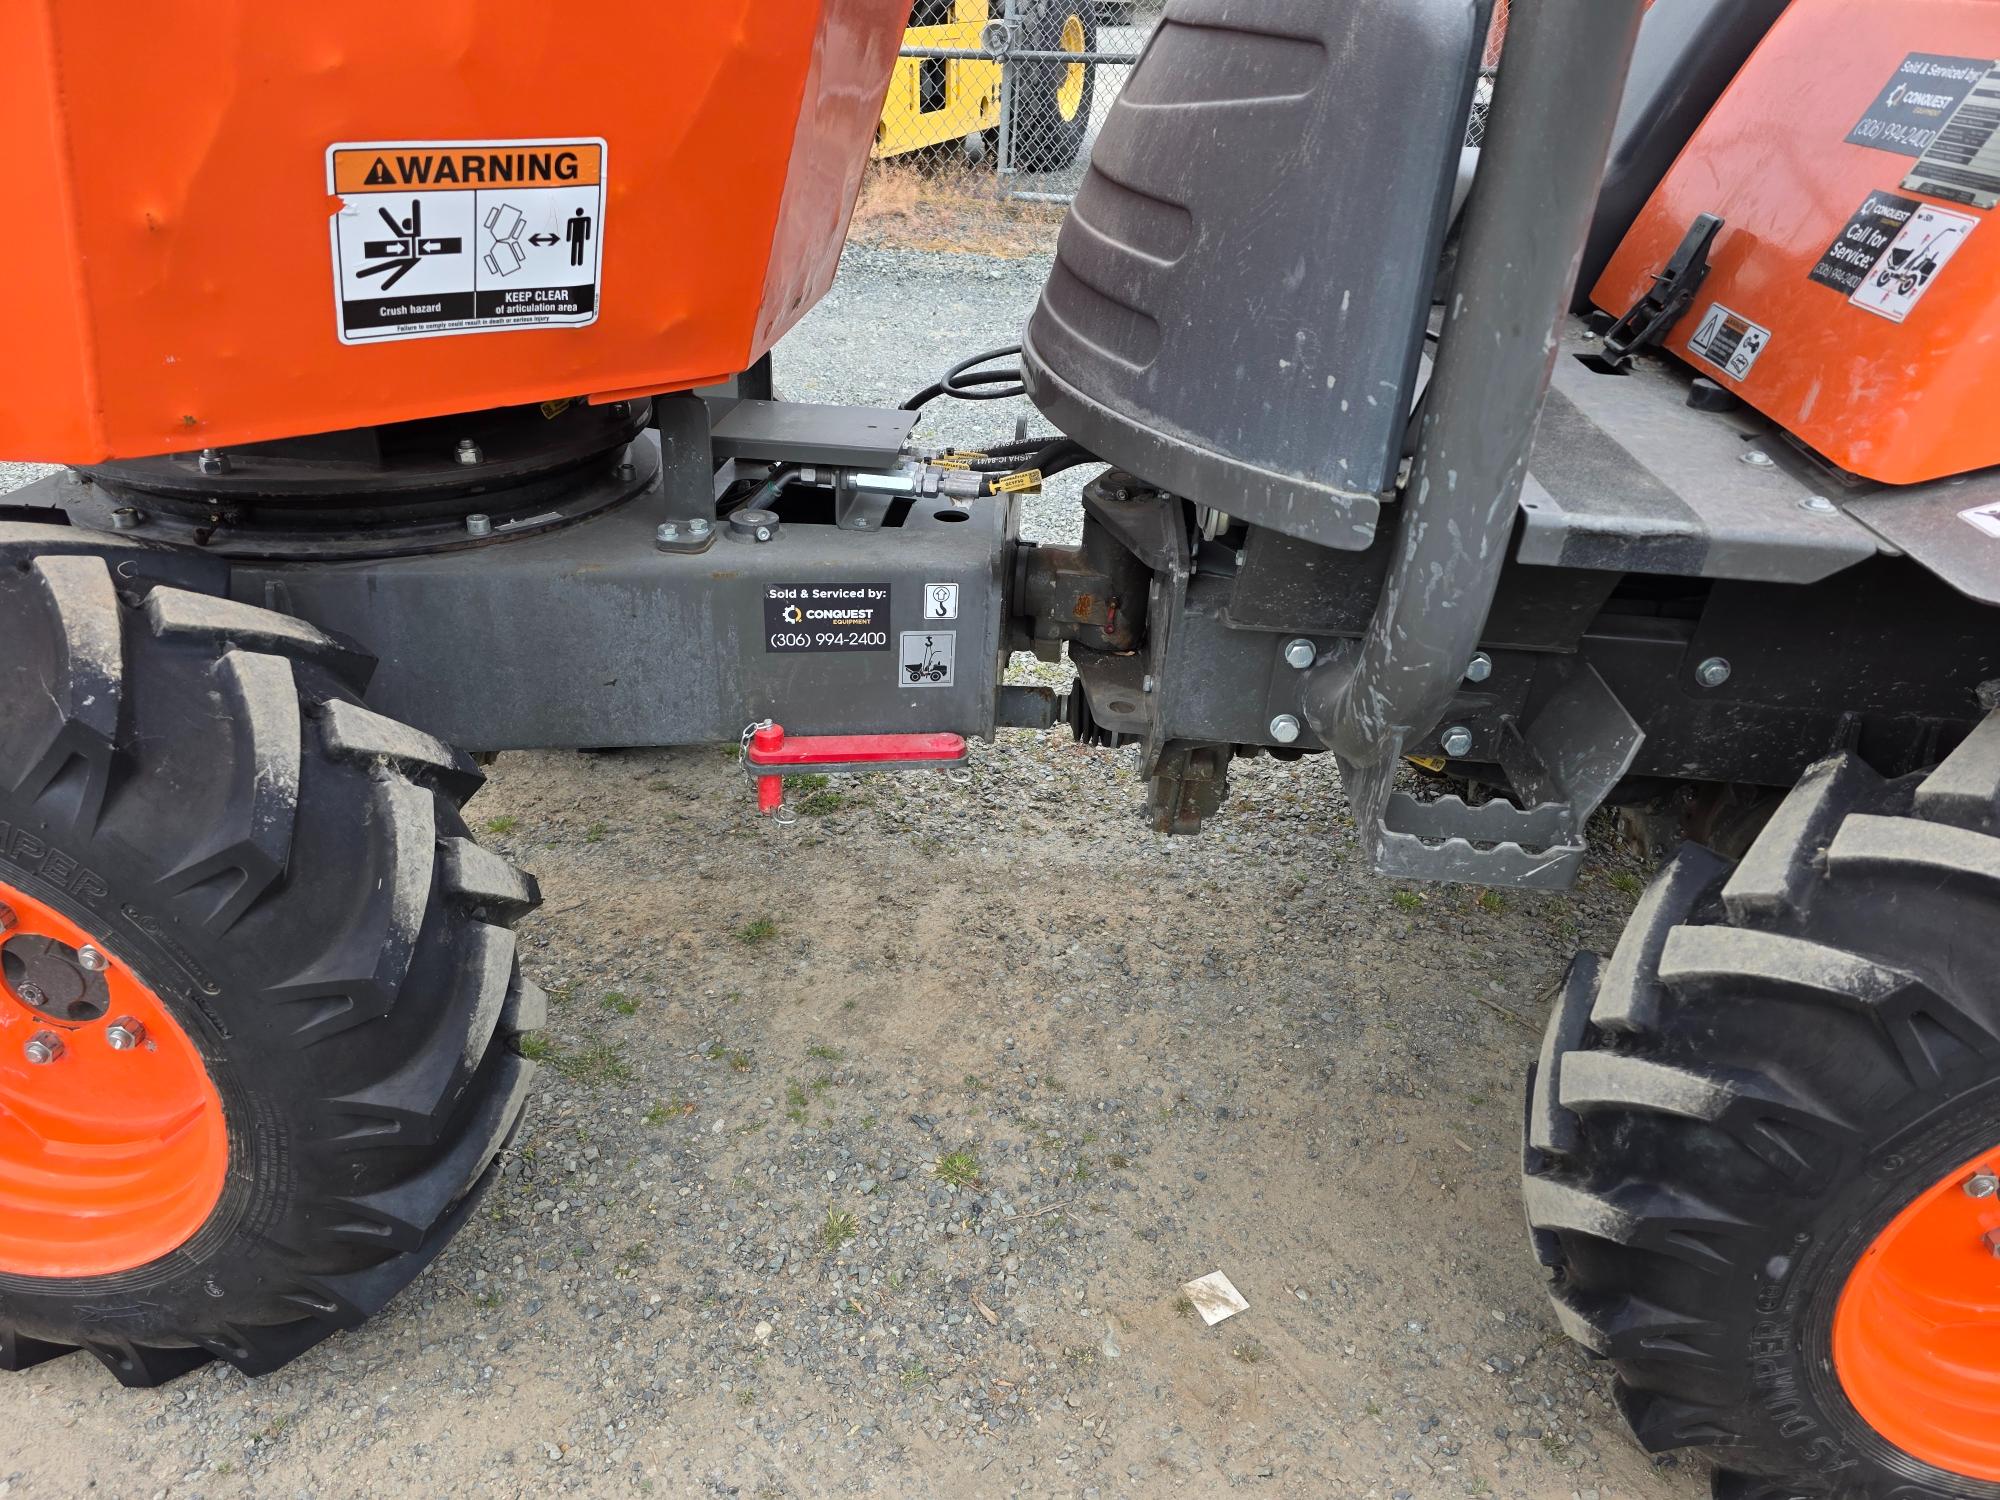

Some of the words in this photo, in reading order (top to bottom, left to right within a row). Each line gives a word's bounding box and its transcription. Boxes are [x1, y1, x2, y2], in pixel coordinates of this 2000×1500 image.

[395, 152, 578, 184] WARNING
[1846, 223, 1870, 244] Call
[1868, 228, 1888, 248] for
[1830, 241, 1874, 269] Service:
[505, 291, 533, 303] KEEP
[535, 290, 569, 302] CLEAR
[380, 305, 407, 317] Crush
[410, 302, 441, 315] hazard
[495, 306, 504, 314] of
[507, 303, 555, 314] articulation
[558, 304, 578, 313] area
[769, 588, 797, 599] Sold
[800, 589, 809, 599] &
[812, 588, 865, 599] Serviced
[868, 588, 886, 600] by:
[806, 609, 874, 620] CONQUEST
[770, 633, 811, 648] (306)
[815, 632, 886, 646] 994-2400
